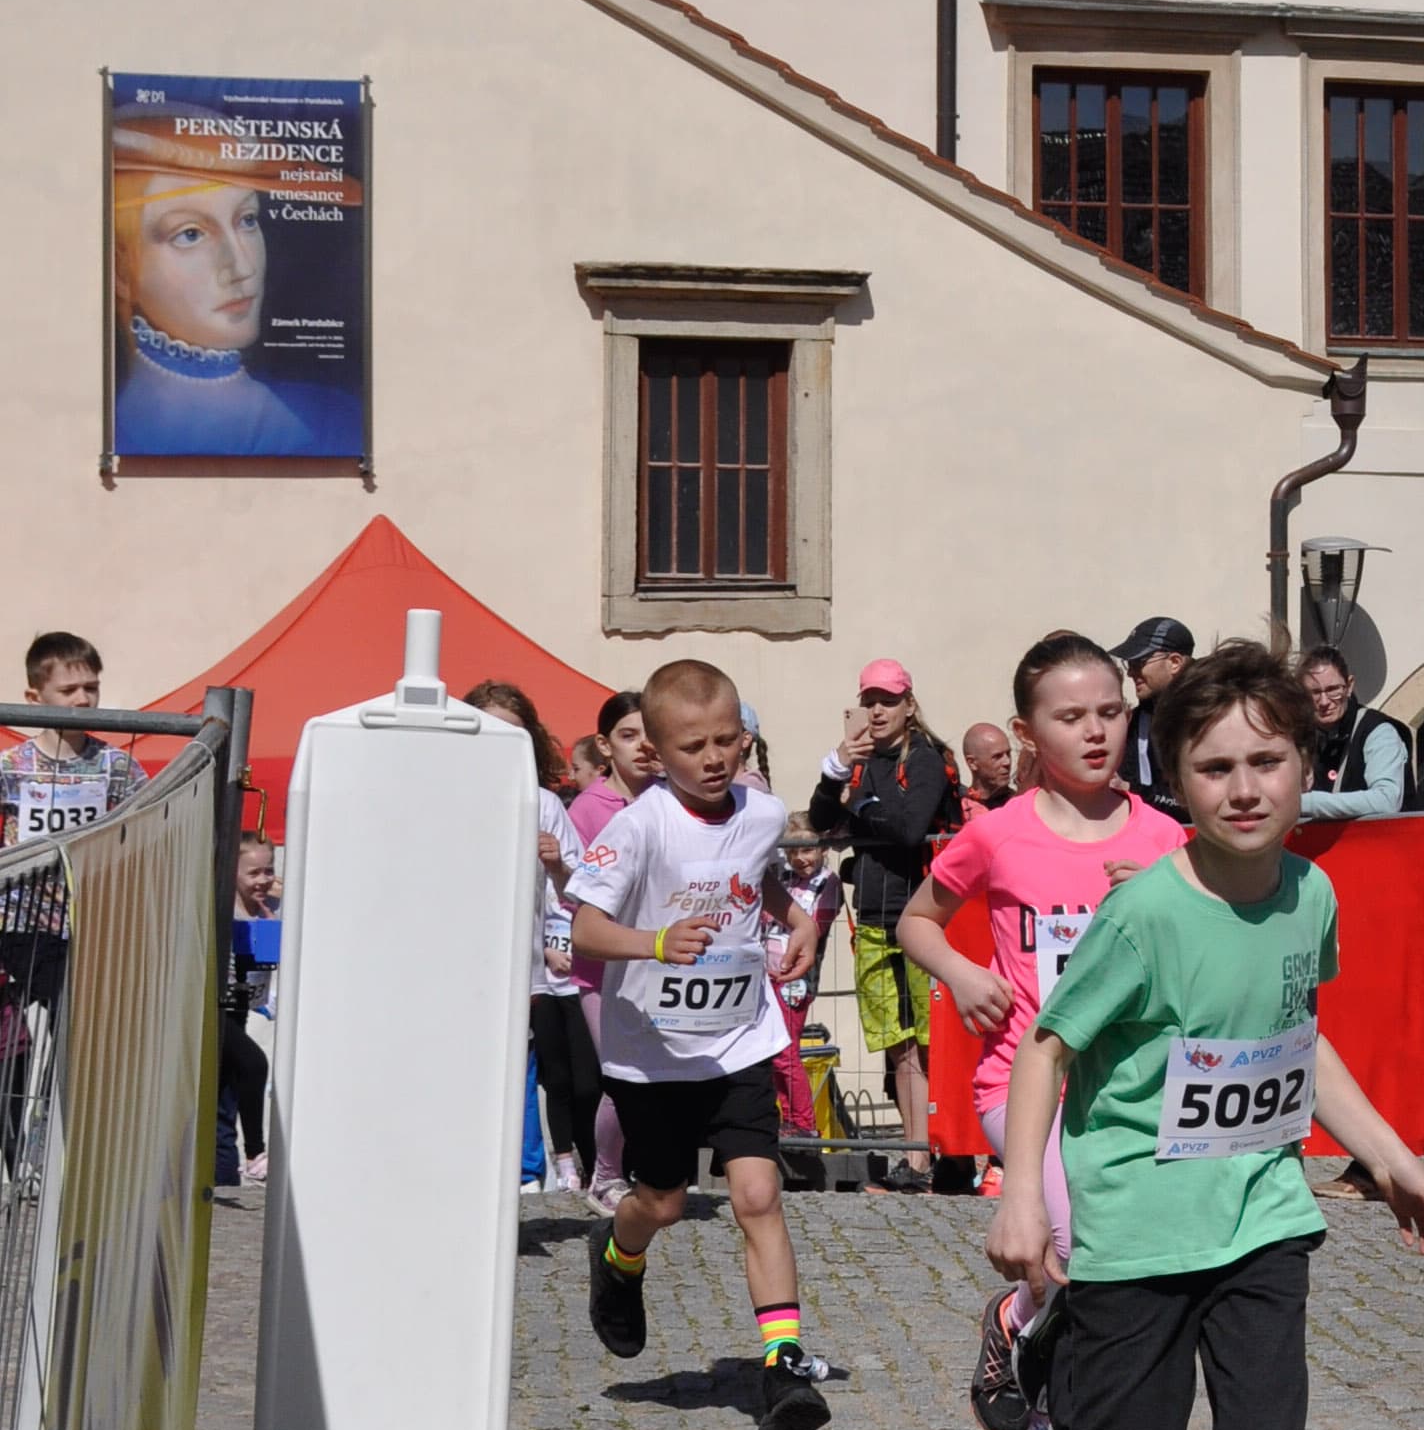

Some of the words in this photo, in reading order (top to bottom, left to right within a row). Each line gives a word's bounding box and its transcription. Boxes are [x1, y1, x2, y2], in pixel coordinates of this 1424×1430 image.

[174, 116, 343, 139] PERNŠTEJNSKÁ
[220, 142, 344, 162] REZIDENCE
[279, 167, 343, 184] nejstarší
[269, 189, 344, 202] renesance
[268, 208, 278, 220] v
[281, 204, 344, 221] Čechách
[688, 881, 720, 892] PVZP
[660, 890, 727, 911] Fénix
[658, 974, 752, 1010] 5077
[1251, 1044, 1283, 1062] PVZP
[1177, 1068, 1305, 1129] 5092
[1181, 1142, 1210, 1154] PVZP
